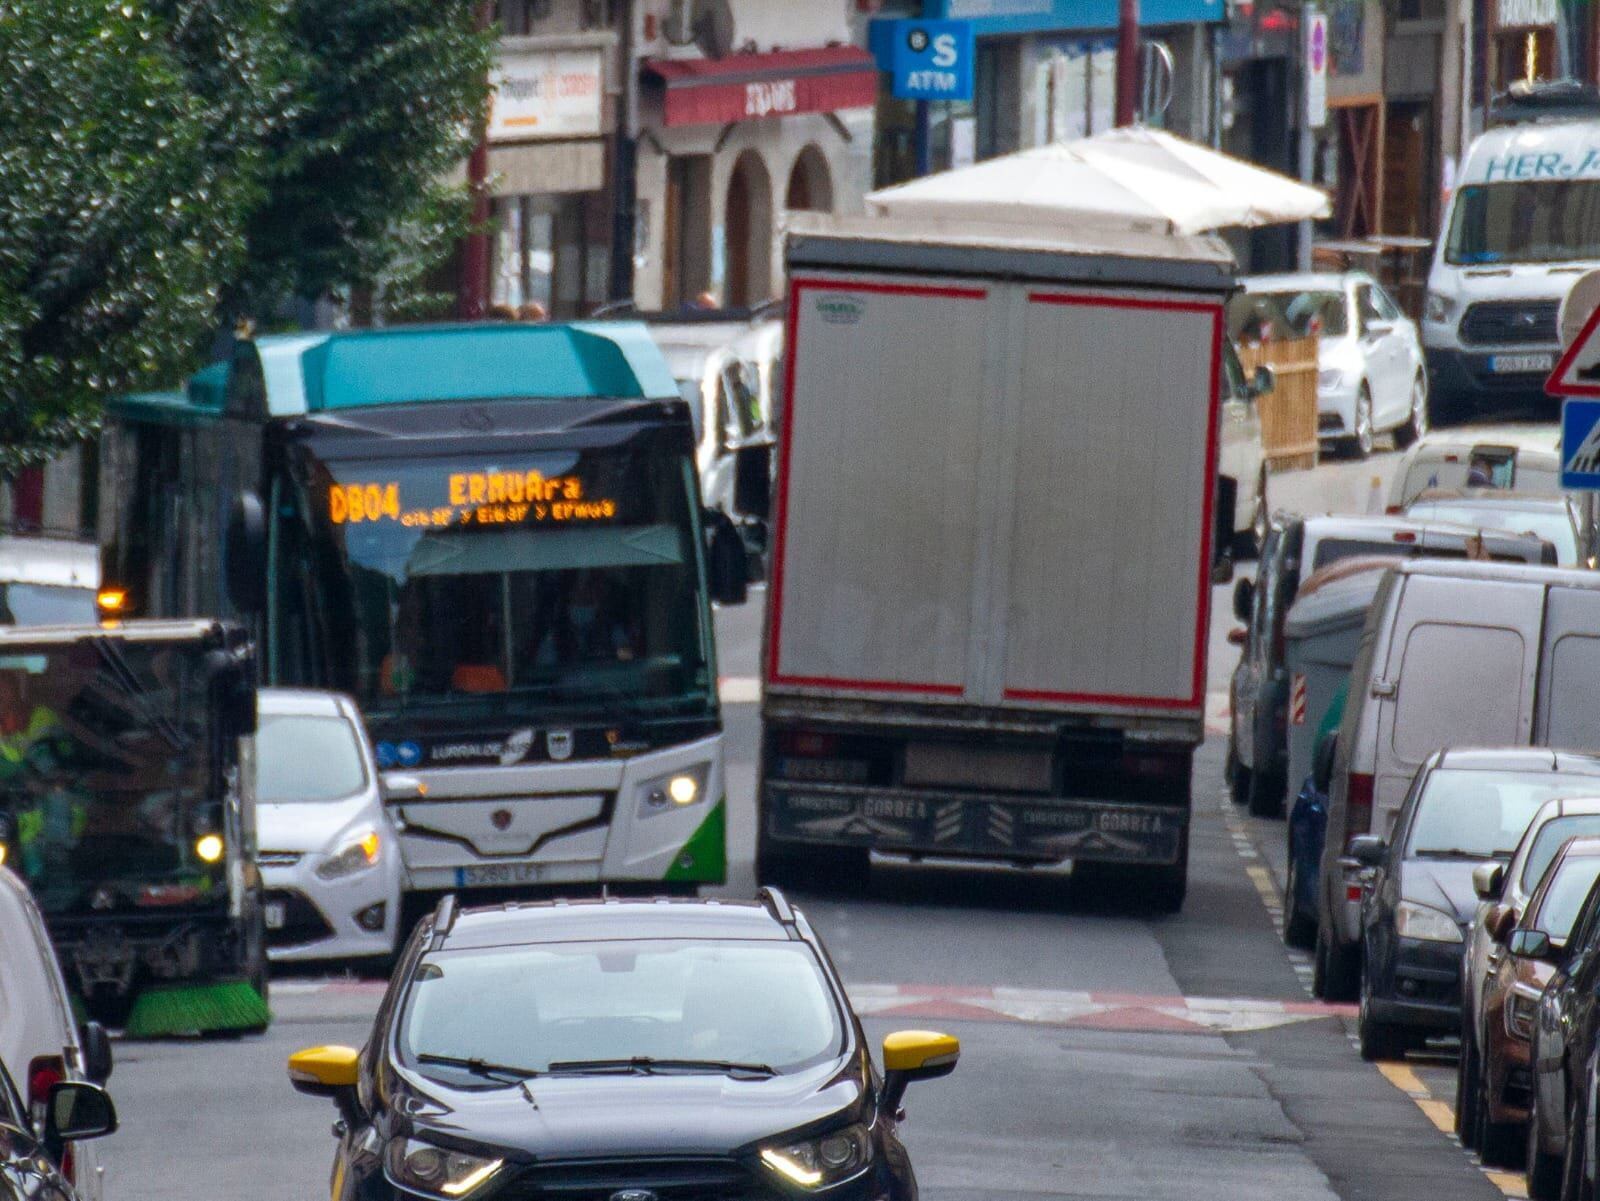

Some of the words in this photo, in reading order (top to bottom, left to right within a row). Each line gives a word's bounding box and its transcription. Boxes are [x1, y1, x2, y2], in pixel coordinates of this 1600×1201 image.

[932, 33, 958, 67] S
[907, 71, 957, 91] ATM
[329, 483, 400, 524] DB04
